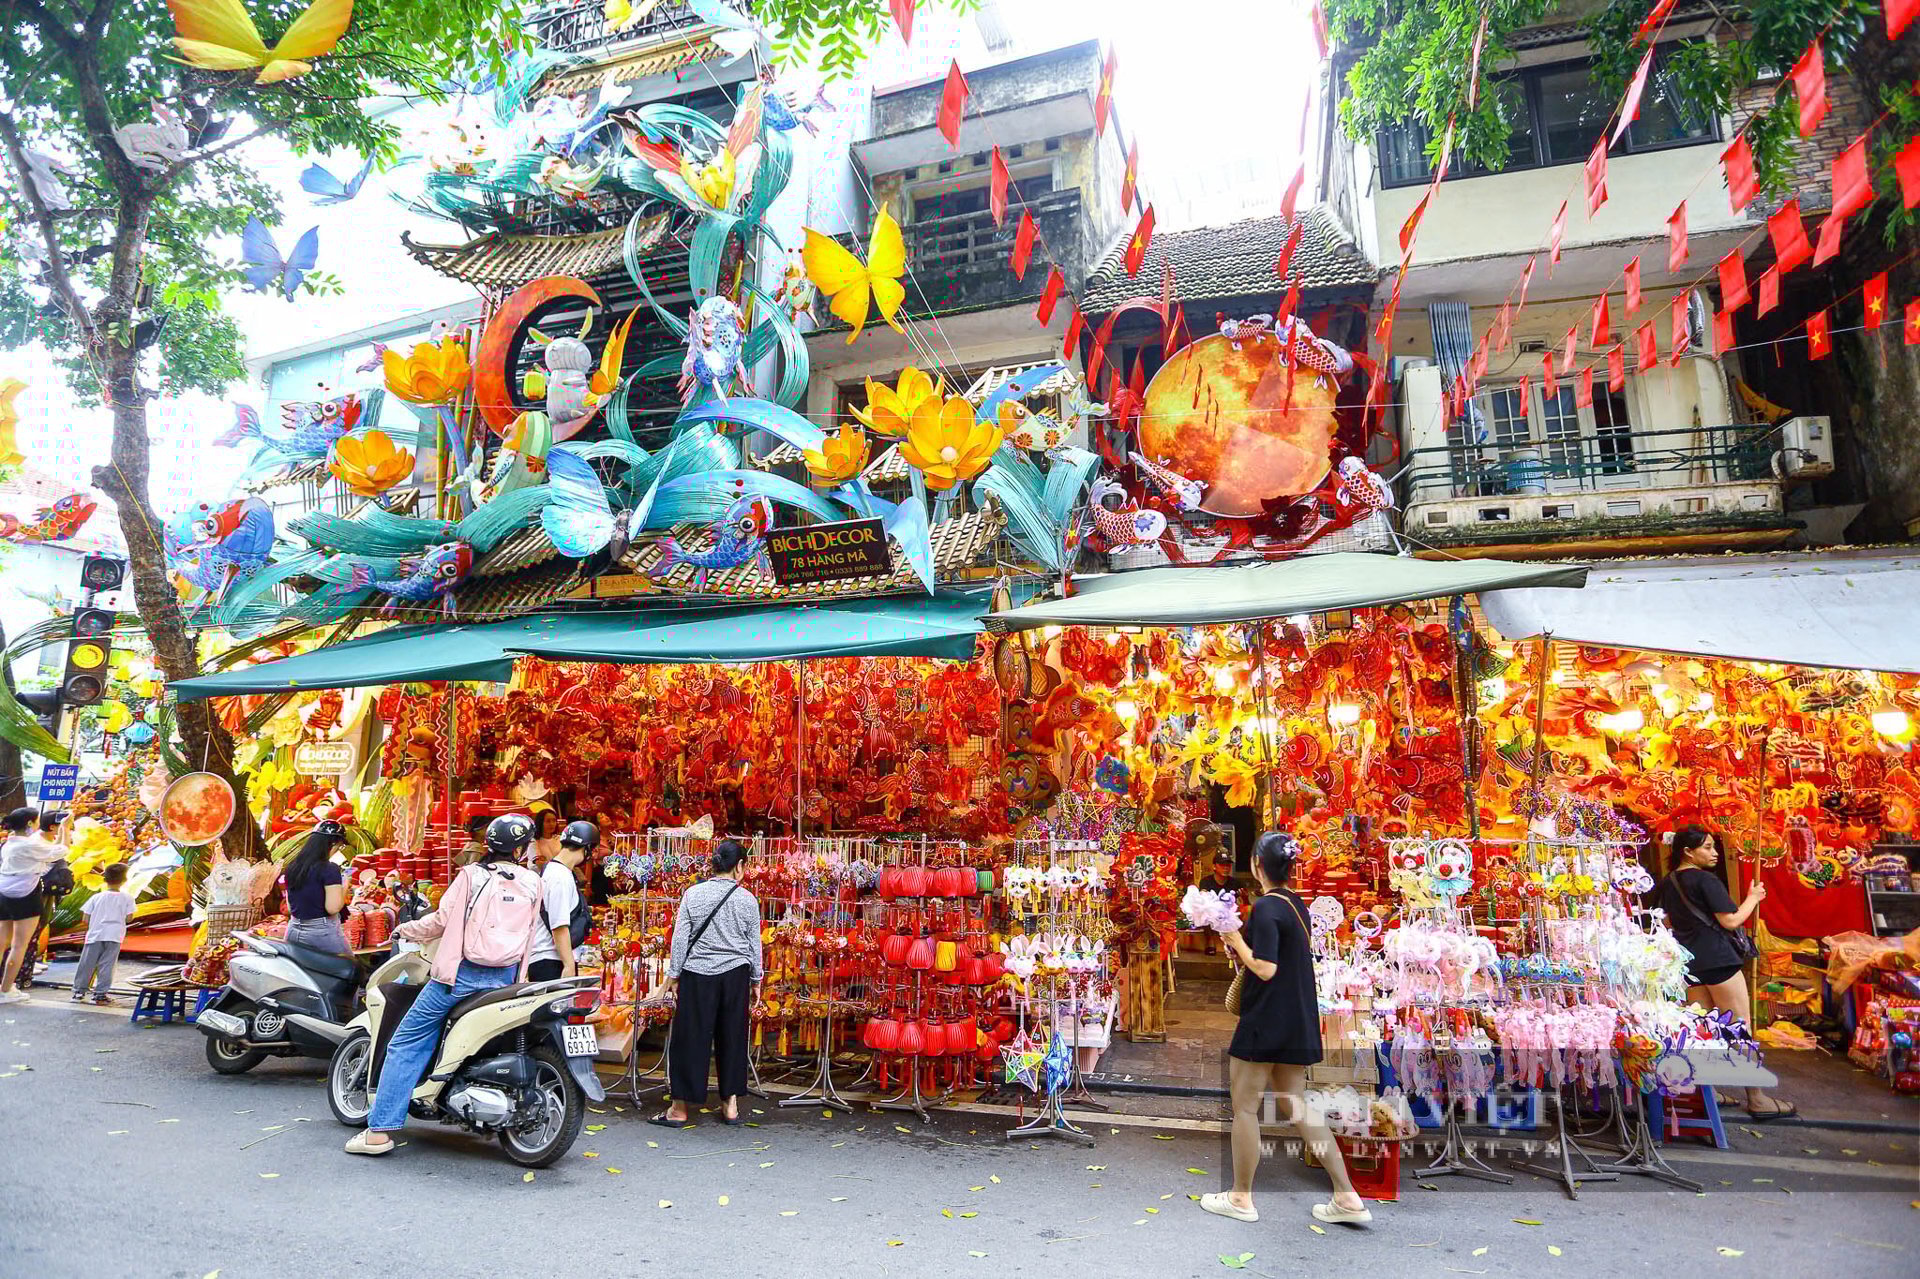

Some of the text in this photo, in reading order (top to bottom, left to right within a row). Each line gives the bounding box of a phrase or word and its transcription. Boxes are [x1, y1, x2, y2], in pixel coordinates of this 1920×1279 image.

[791, 549, 867, 568] 78 HÀNG MÃ
[47, 767, 60, 776] NÚT
[568, 1026, 592, 1040] 29-K1
[568, 1040, 597, 1054] 693.23
